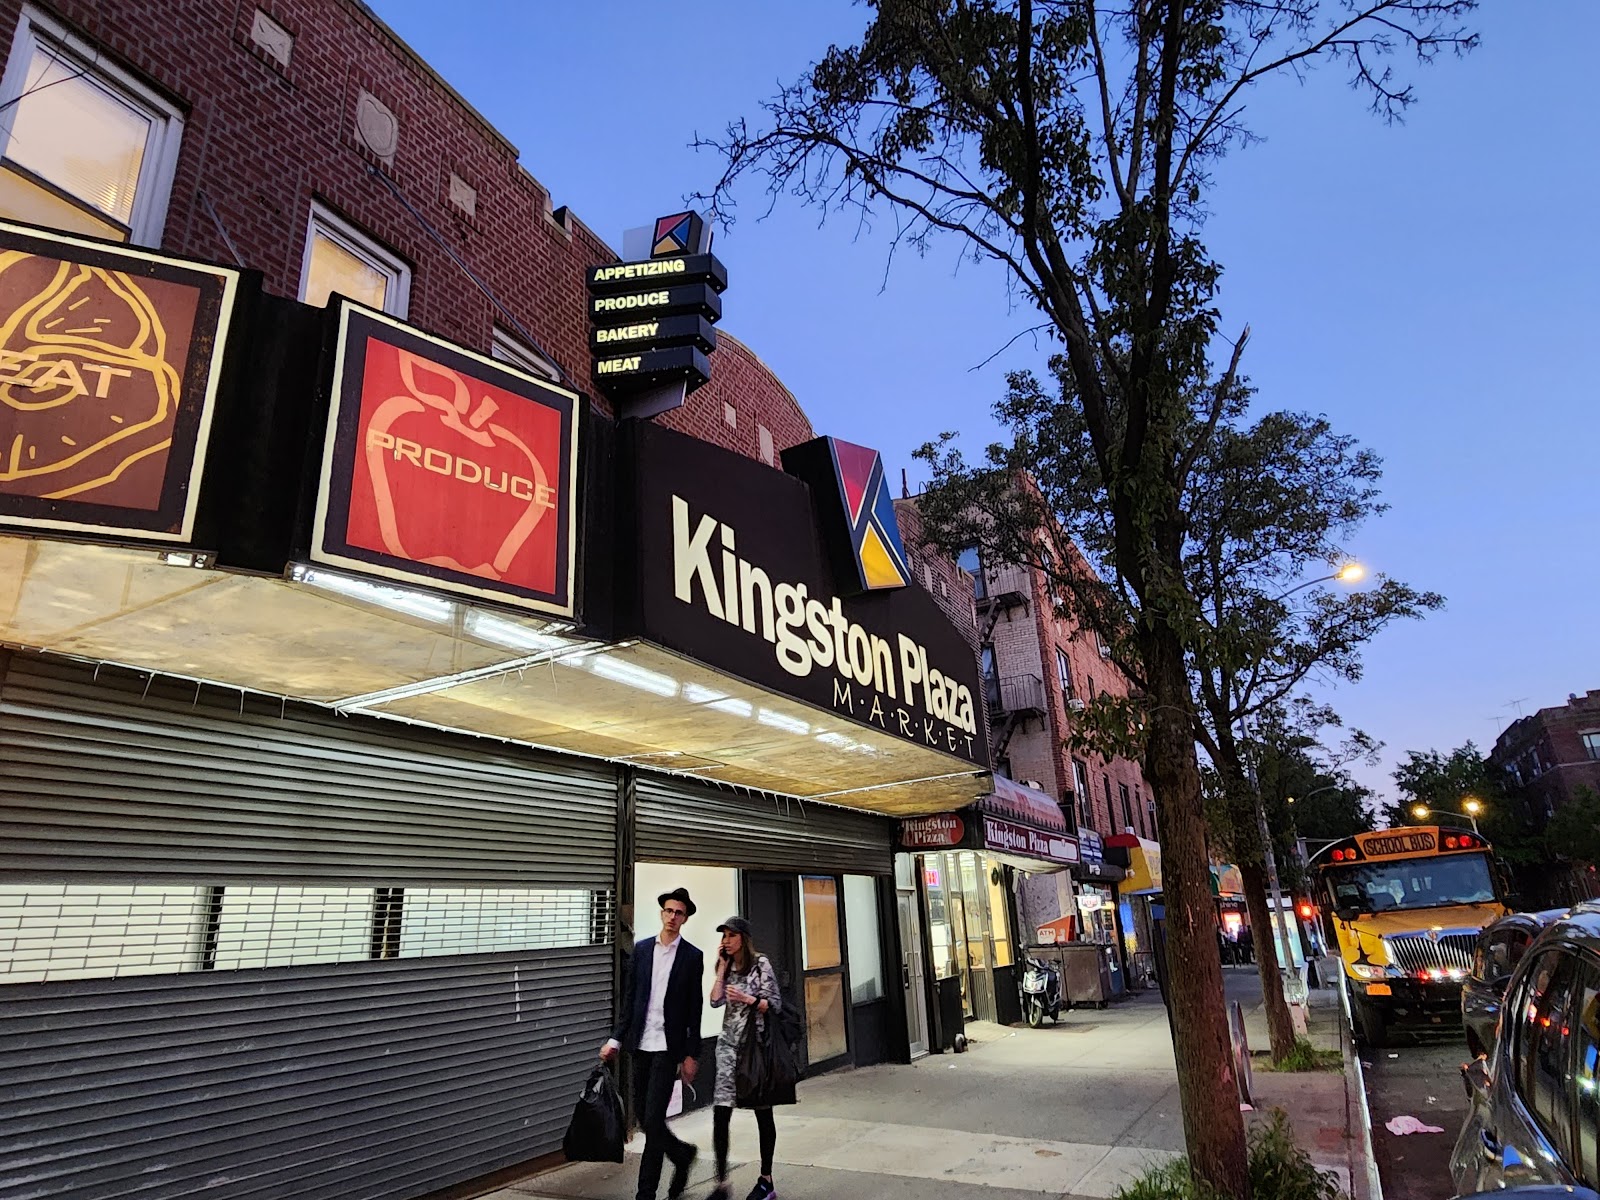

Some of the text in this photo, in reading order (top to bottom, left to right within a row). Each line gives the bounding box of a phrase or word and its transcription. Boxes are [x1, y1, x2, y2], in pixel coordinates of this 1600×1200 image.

[594, 259, 686, 281] APPETIZING
[594, 291, 669, 311] PRODUCE
[596, 323, 659, 342] BAKERY
[0, 350, 132, 398] EAT
[597, 357, 641, 374] MEAT
[366, 428, 556, 509] PRODUCE
[672, 494, 977, 735] Kingston Plaza
[903, 818, 957, 834] Kingston
[986, 820, 1027, 849] Kingston
[1028, 831, 1049, 854] Pizza
[914, 831, 945, 844] Pizza
[1366, 833, 1433, 855] SCHOOL BUS
